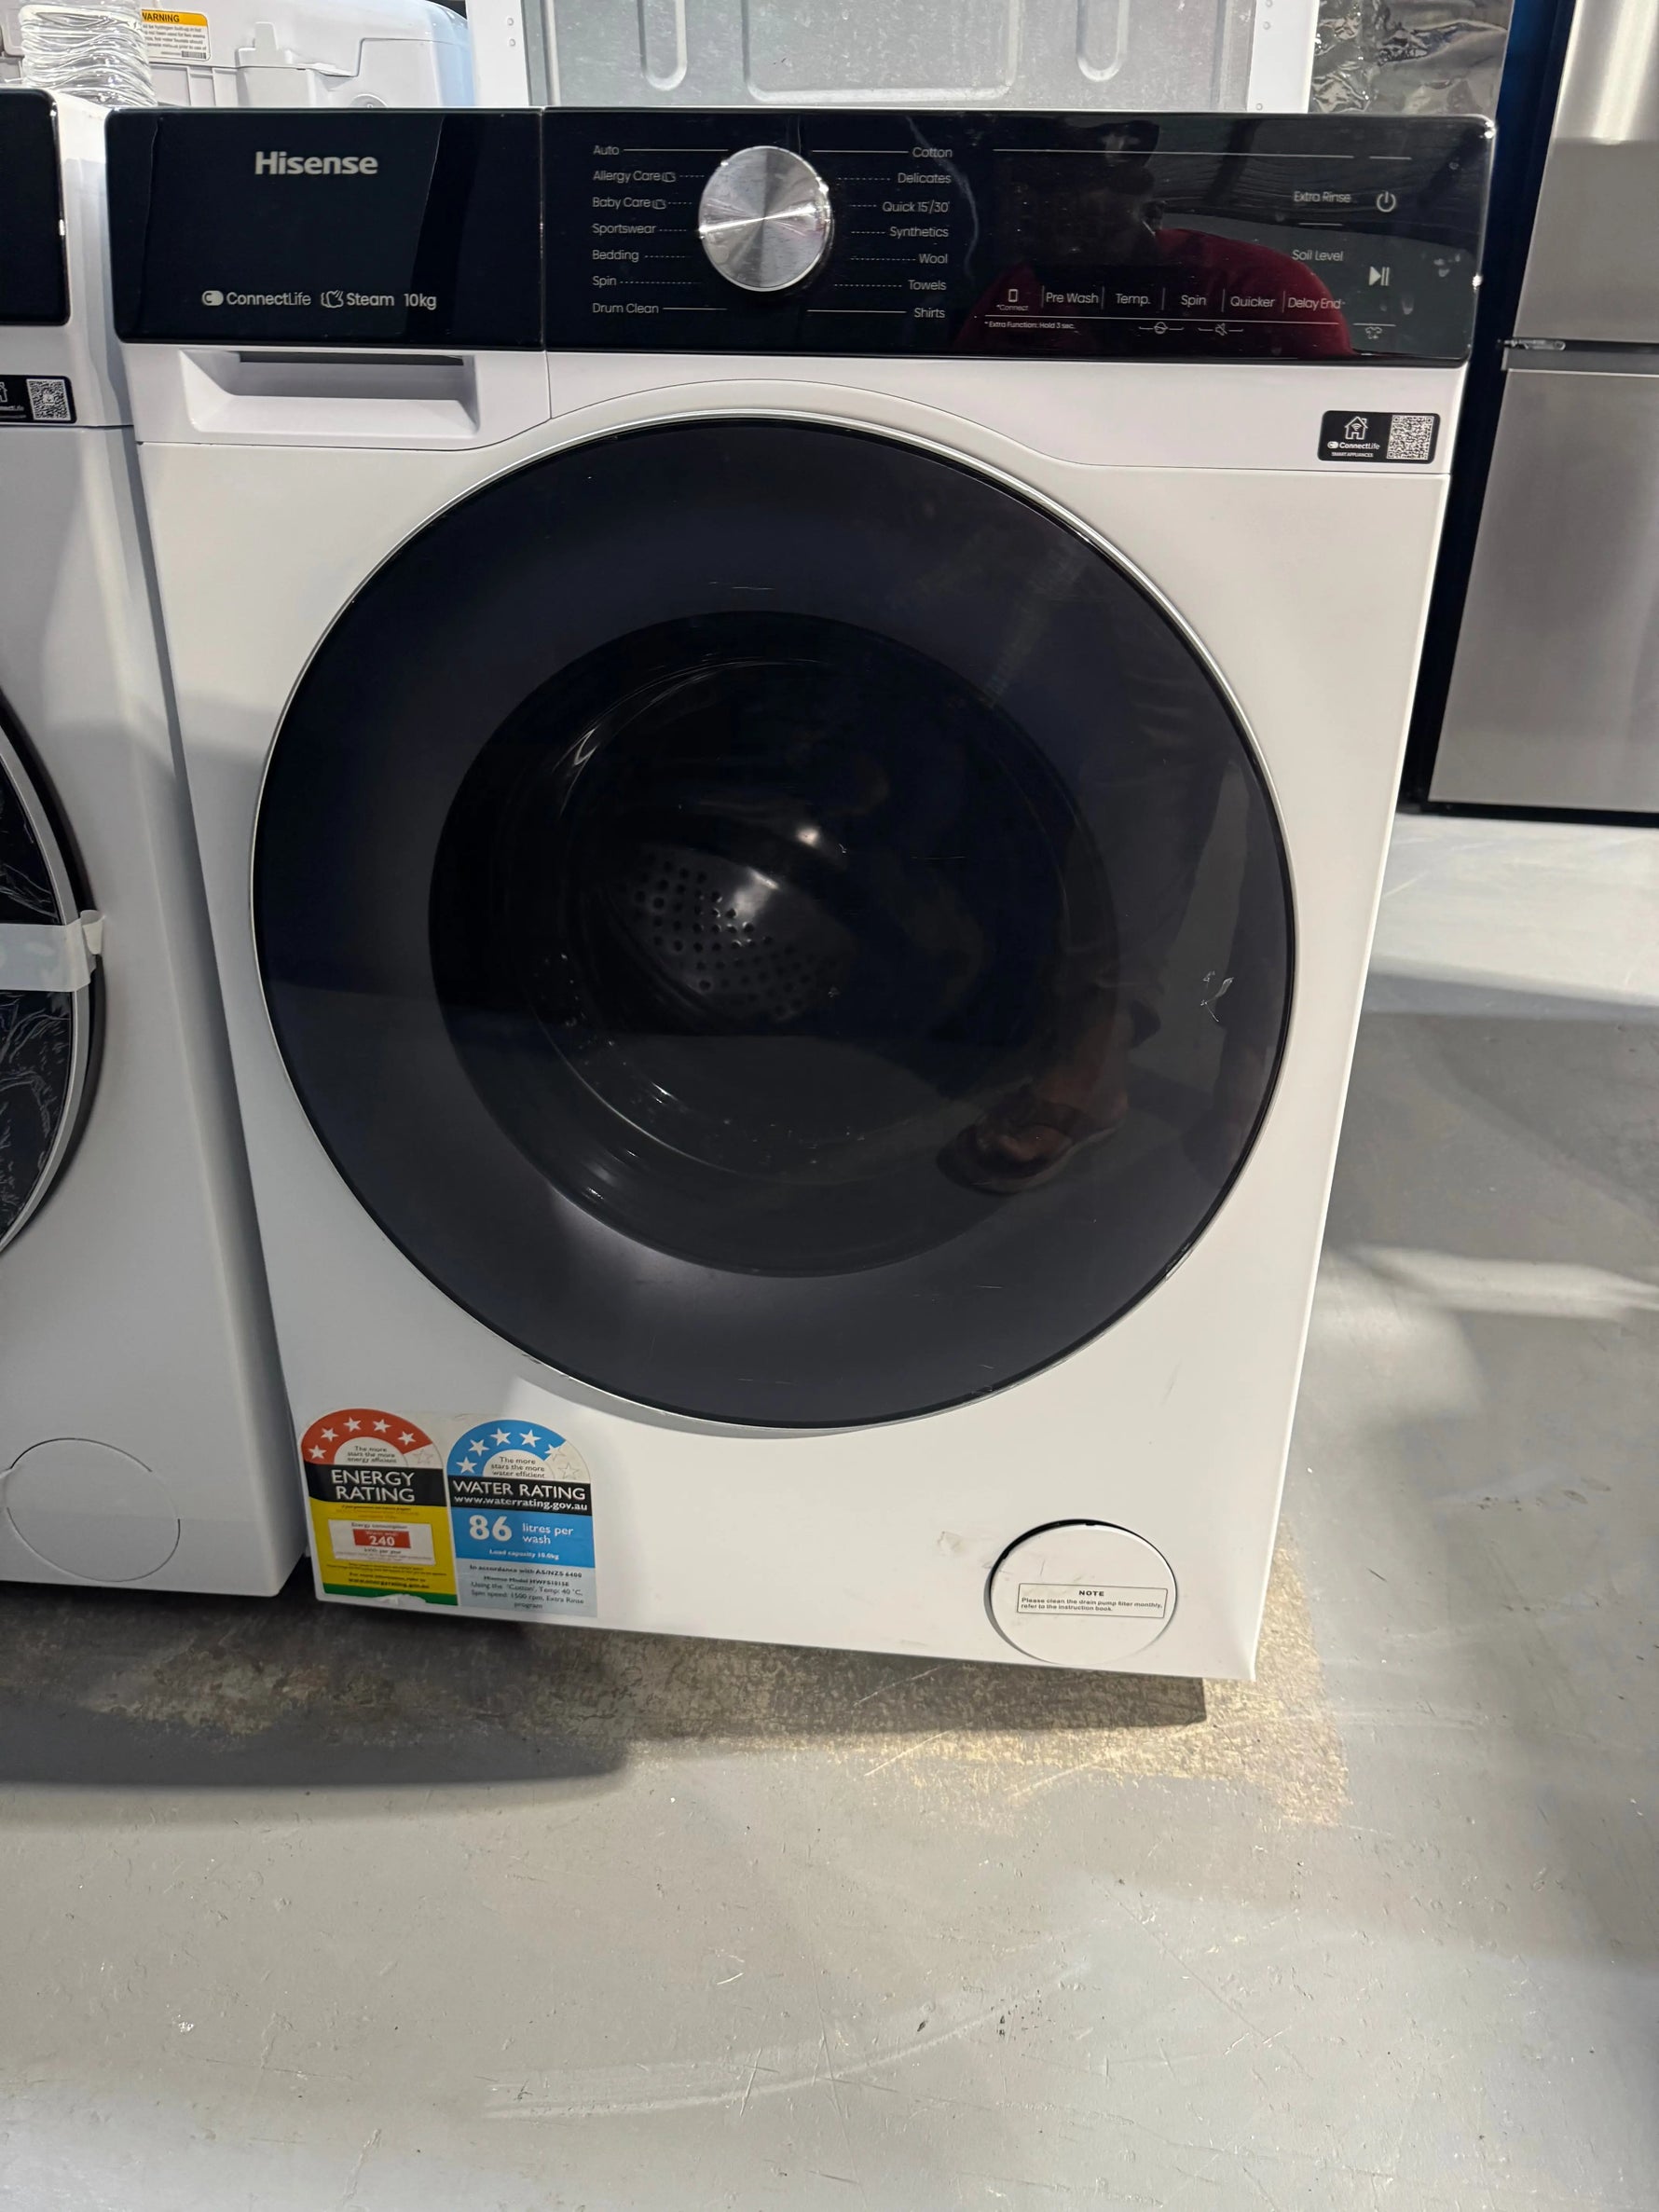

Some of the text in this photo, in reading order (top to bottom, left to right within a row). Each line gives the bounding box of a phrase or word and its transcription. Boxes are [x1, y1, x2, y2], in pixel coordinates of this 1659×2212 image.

[593, 145, 620, 156] Auto
[912, 147, 953, 158] Cotton
[254, 151, 378, 175] Hisense
[593, 171, 661, 184] Allergy Care
[898, 172, 952, 184] Delicates
[1294, 191, 1351, 203] Extra Rinse
[592, 197, 651, 210] Baby Care
[882, 201, 915, 213] Quick
[592, 224, 656, 236] Sportswear
[889, 227, 949, 239] Synthetics
[592, 249, 639, 263] Bedding
[919, 254, 948, 264] Wool
[1292, 249, 1344, 262] Soil Level
[592, 276, 617, 288] Spin
[908, 280, 947, 290] Towels
[226, 292, 437, 310] ConnectLife Steam 10kg
[1046, 292, 1099, 304] Pre Wash
[1116, 293, 1151, 307] Temp.
[1181, 295, 1207, 308] Spin
[1230, 295, 1275, 308] Quicker
[1288, 297, 1318, 311] Delay
[592, 303, 659, 313] Drum Clean
[914, 307, 945, 318] Shirts
[1339, 442, 1379, 450] ConnectLife
[331, 1469, 416, 1487] ENERGY
[336, 1485, 416, 1503] RATING
[453, 1480, 586, 1501] WATER RATING
[454, 1496, 587, 1511] www.waterrating.gov.au
[469, 1514, 512, 1542] 86
[523, 1523, 574, 1536] litres per
[369, 1535, 395, 1546] 240
[522, 1534, 551, 1545] wash
